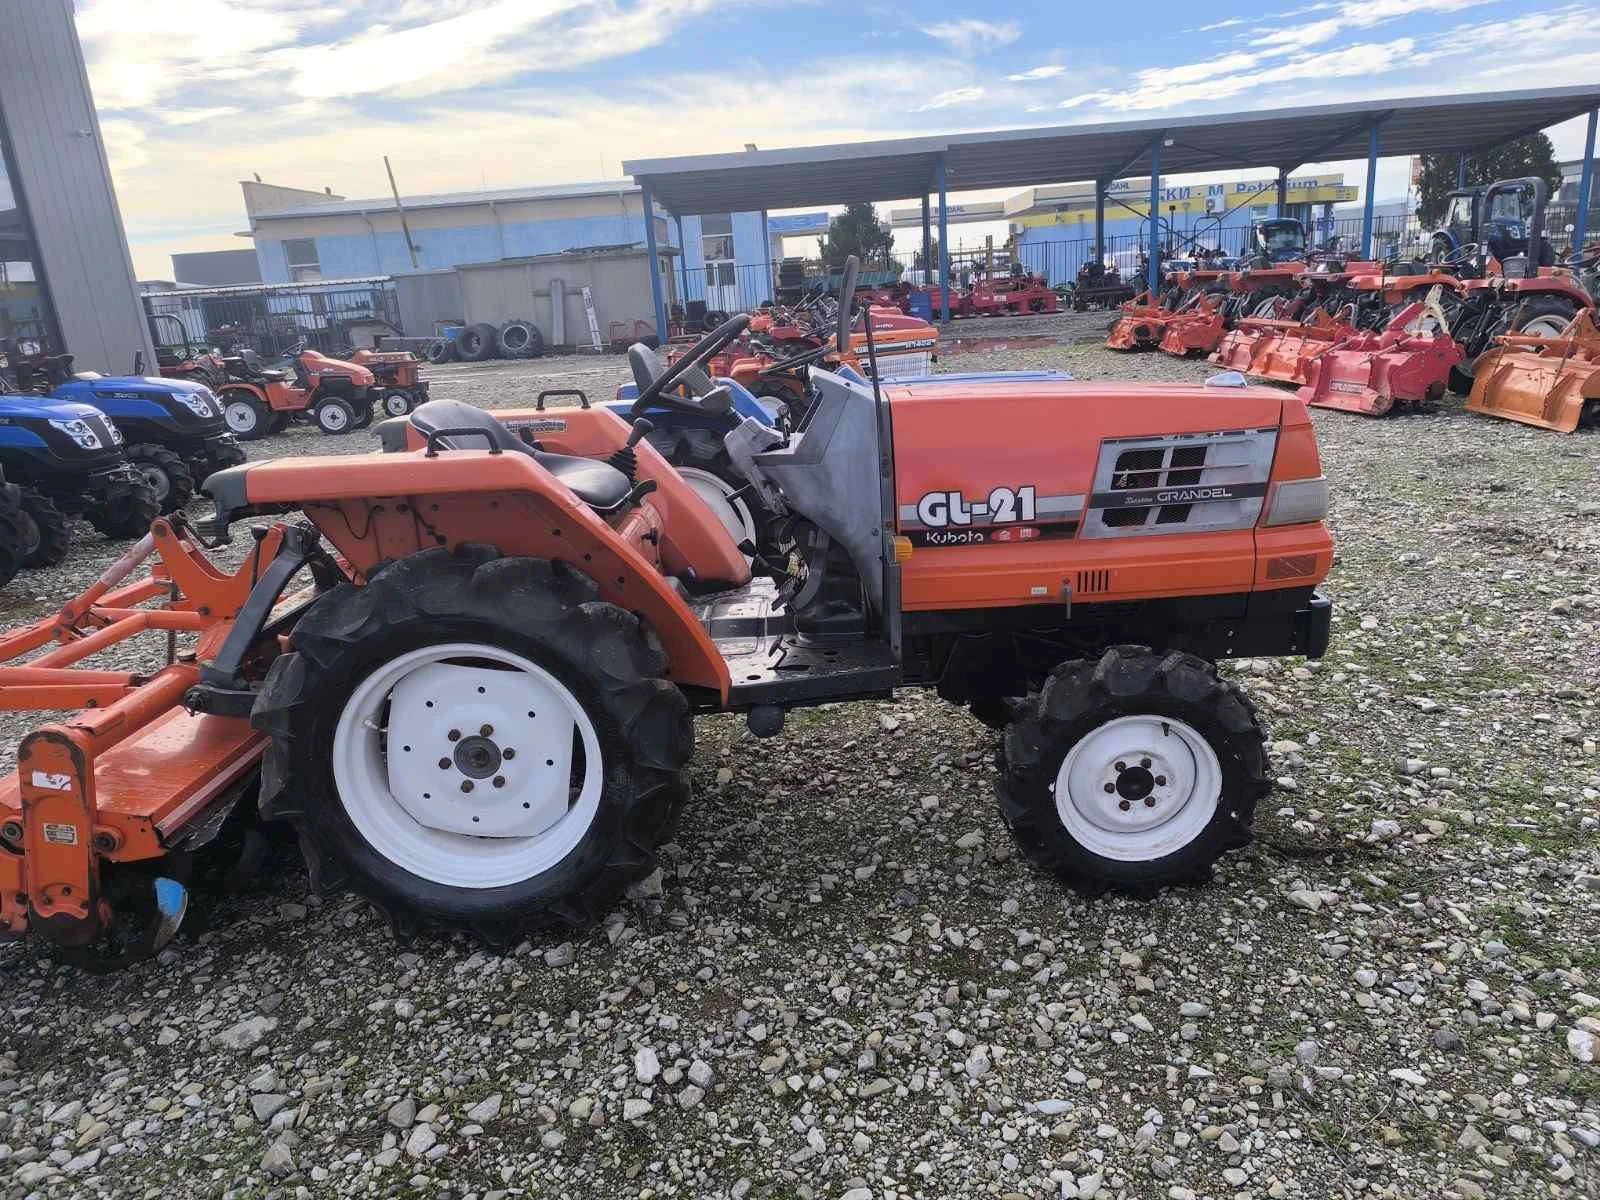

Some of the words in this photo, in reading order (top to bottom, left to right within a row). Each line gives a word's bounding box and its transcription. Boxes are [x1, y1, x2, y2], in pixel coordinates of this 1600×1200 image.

[1157, 488, 1233, 502] GRANDEL
[917, 485, 1036, 527] GL-21
[926, 530, 984, 544] Kubota
